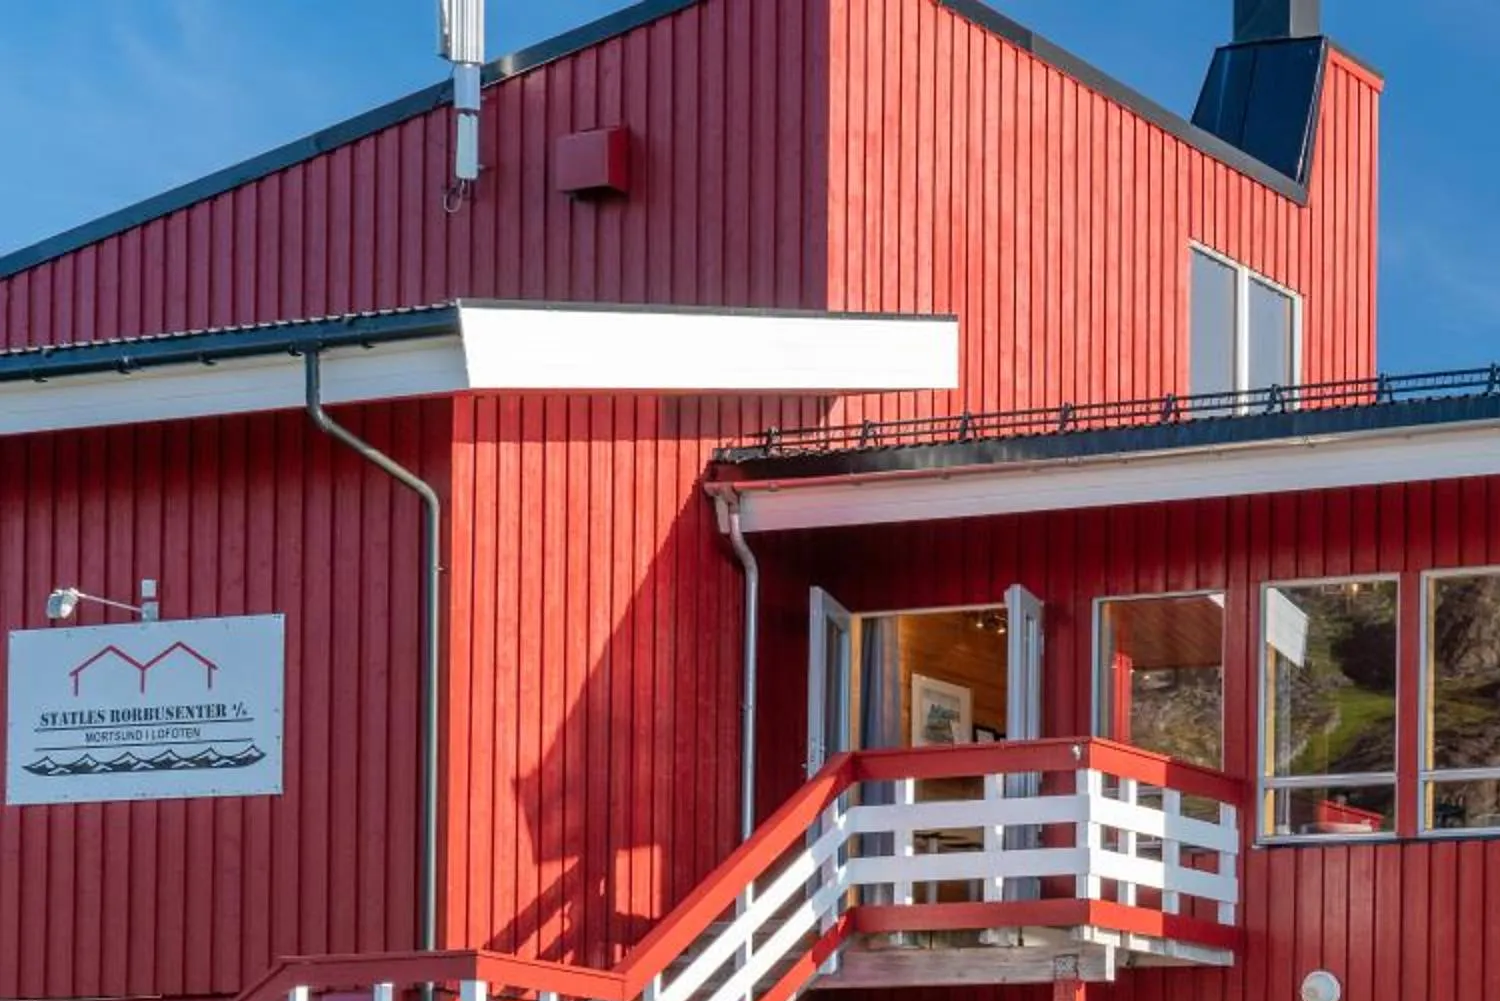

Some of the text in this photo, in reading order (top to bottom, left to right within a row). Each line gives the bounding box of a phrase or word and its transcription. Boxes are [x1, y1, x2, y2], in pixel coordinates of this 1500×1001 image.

[40, 708, 106, 727] STATLES
[109, 703, 227, 723] RORBUSENTER
[85, 729, 142, 743] MORTSUND
[151, 727, 201, 741] LOFOTEN
